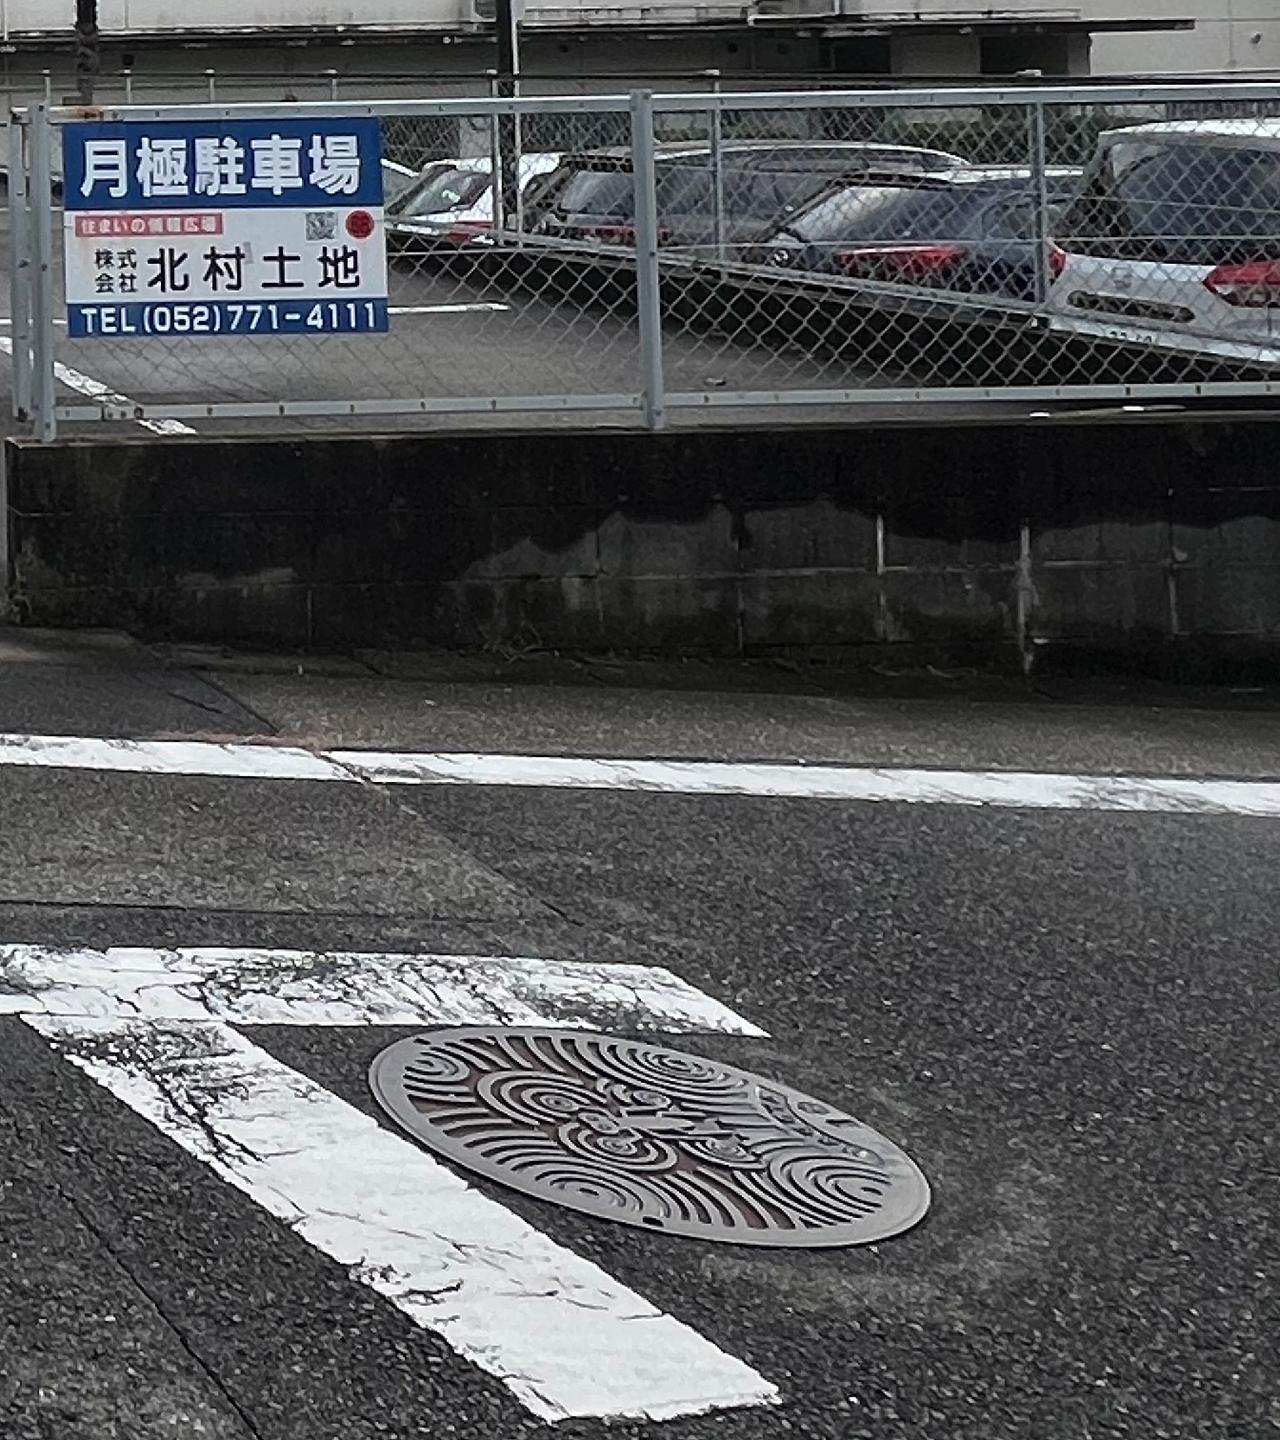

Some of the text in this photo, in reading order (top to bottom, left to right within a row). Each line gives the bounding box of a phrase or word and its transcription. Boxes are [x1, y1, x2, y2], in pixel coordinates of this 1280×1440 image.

[80, 133, 360, 198] 月極駐車場
[146, 244, 361, 293] 北村土地
